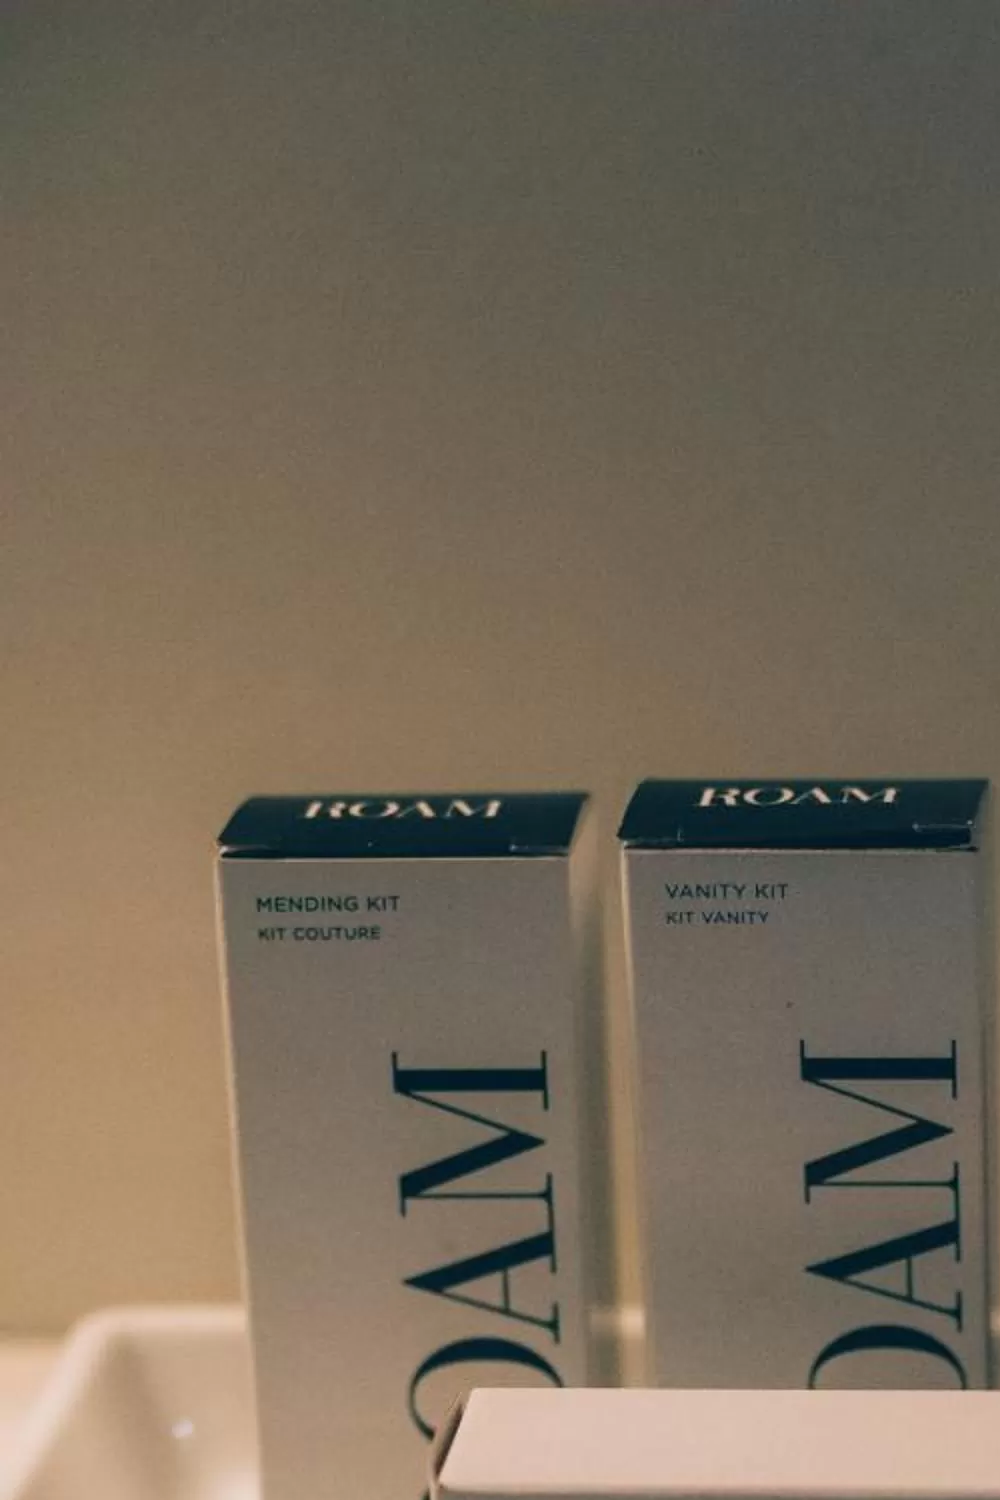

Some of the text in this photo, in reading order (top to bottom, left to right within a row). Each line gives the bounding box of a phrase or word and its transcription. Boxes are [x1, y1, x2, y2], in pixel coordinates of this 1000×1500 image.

[695, 786, 900, 807] ROAM
[299, 800, 501, 819] ROAM
[665, 883, 789, 899] VANITY KIT
[256, 895, 400, 913] MENDING KIT
[666, 911, 769, 925] KIT VANITY
[258, 926, 381, 941] KIT COUTURE
[800, 1039, 967, 1390] OAM
